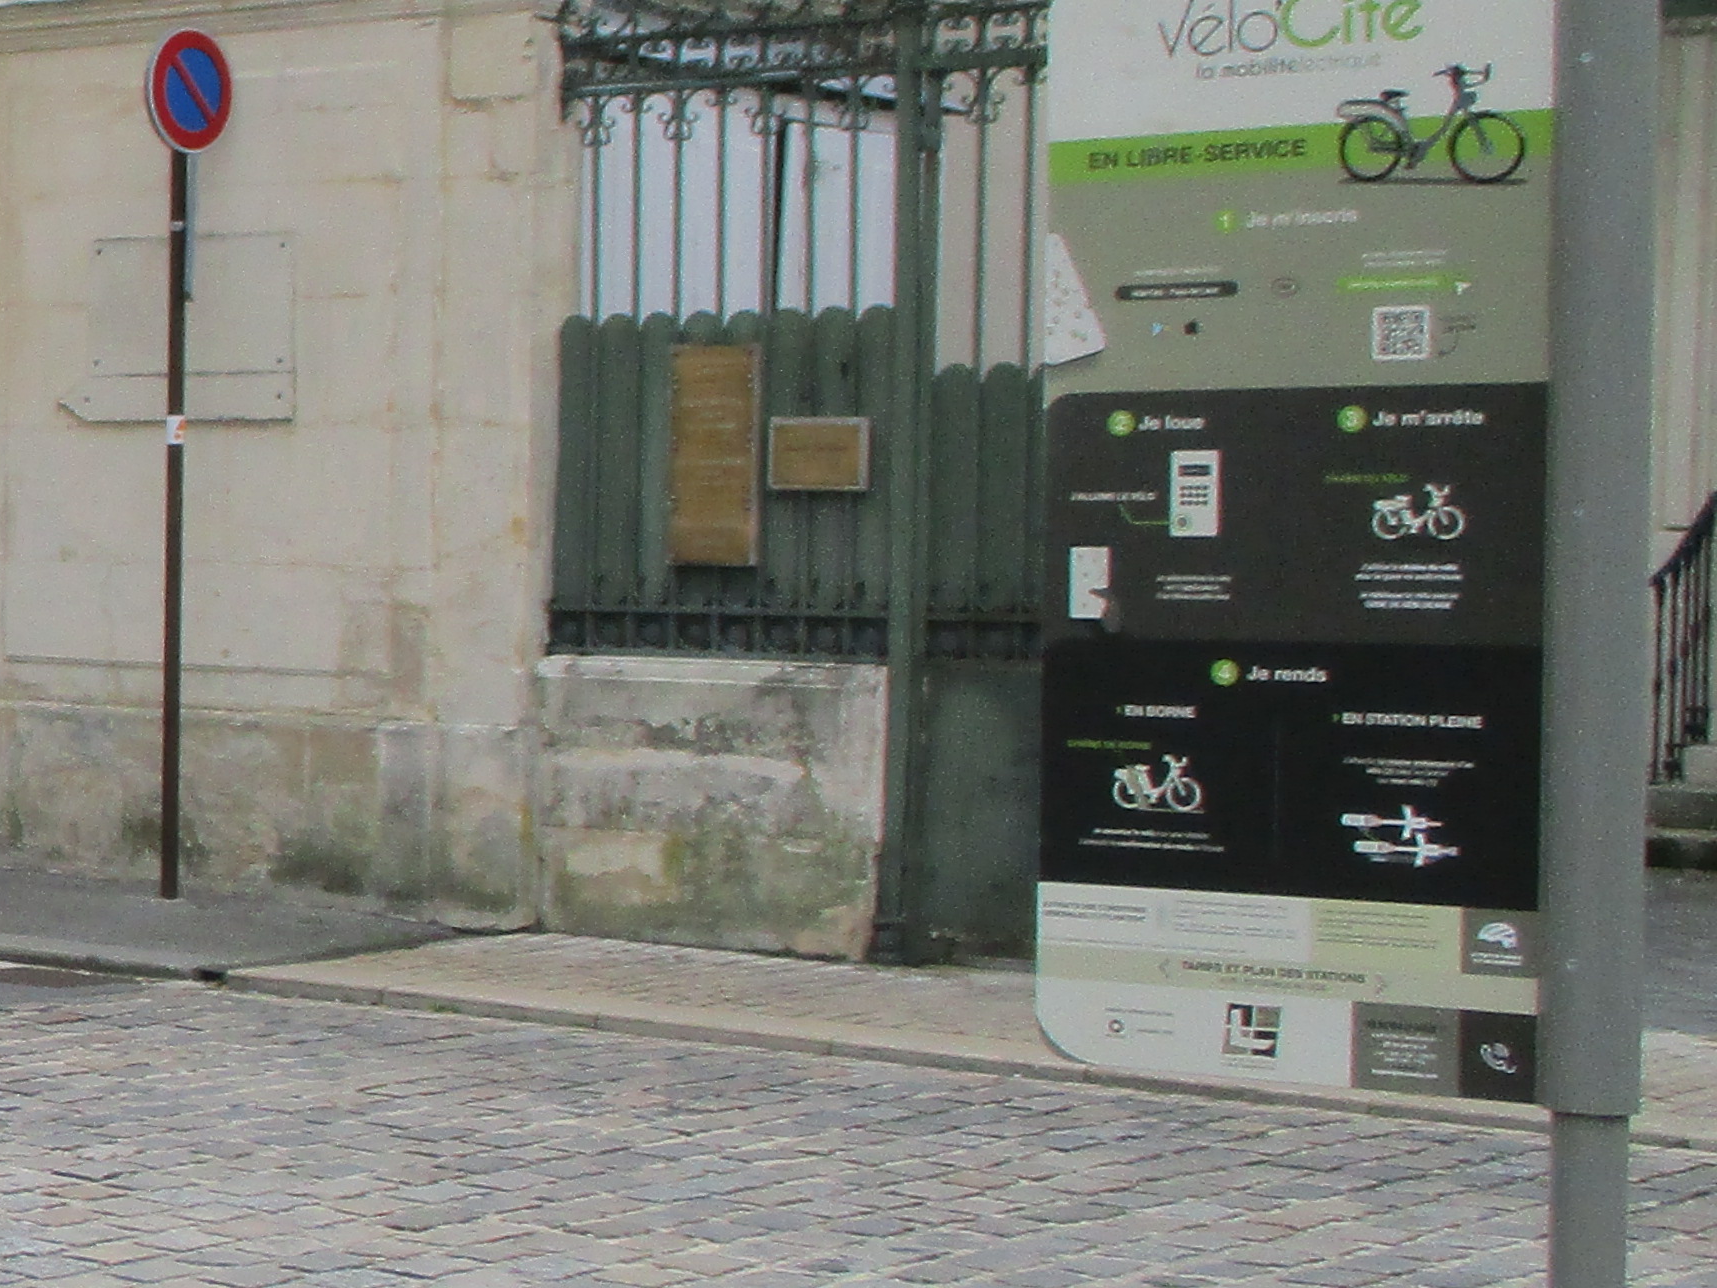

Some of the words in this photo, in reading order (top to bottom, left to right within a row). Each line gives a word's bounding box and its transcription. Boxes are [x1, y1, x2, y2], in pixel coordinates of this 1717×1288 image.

[1087, 151, 1119, 171] EN
[1138, 415, 1161, 431] Je
[1372, 410, 1398, 427] Je
[1246, 665, 1271, 682] Je
[1273, 666, 1329, 683] rends
[1341, 711, 1364, 725] EN
[1366, 712, 1428, 727] STATION
